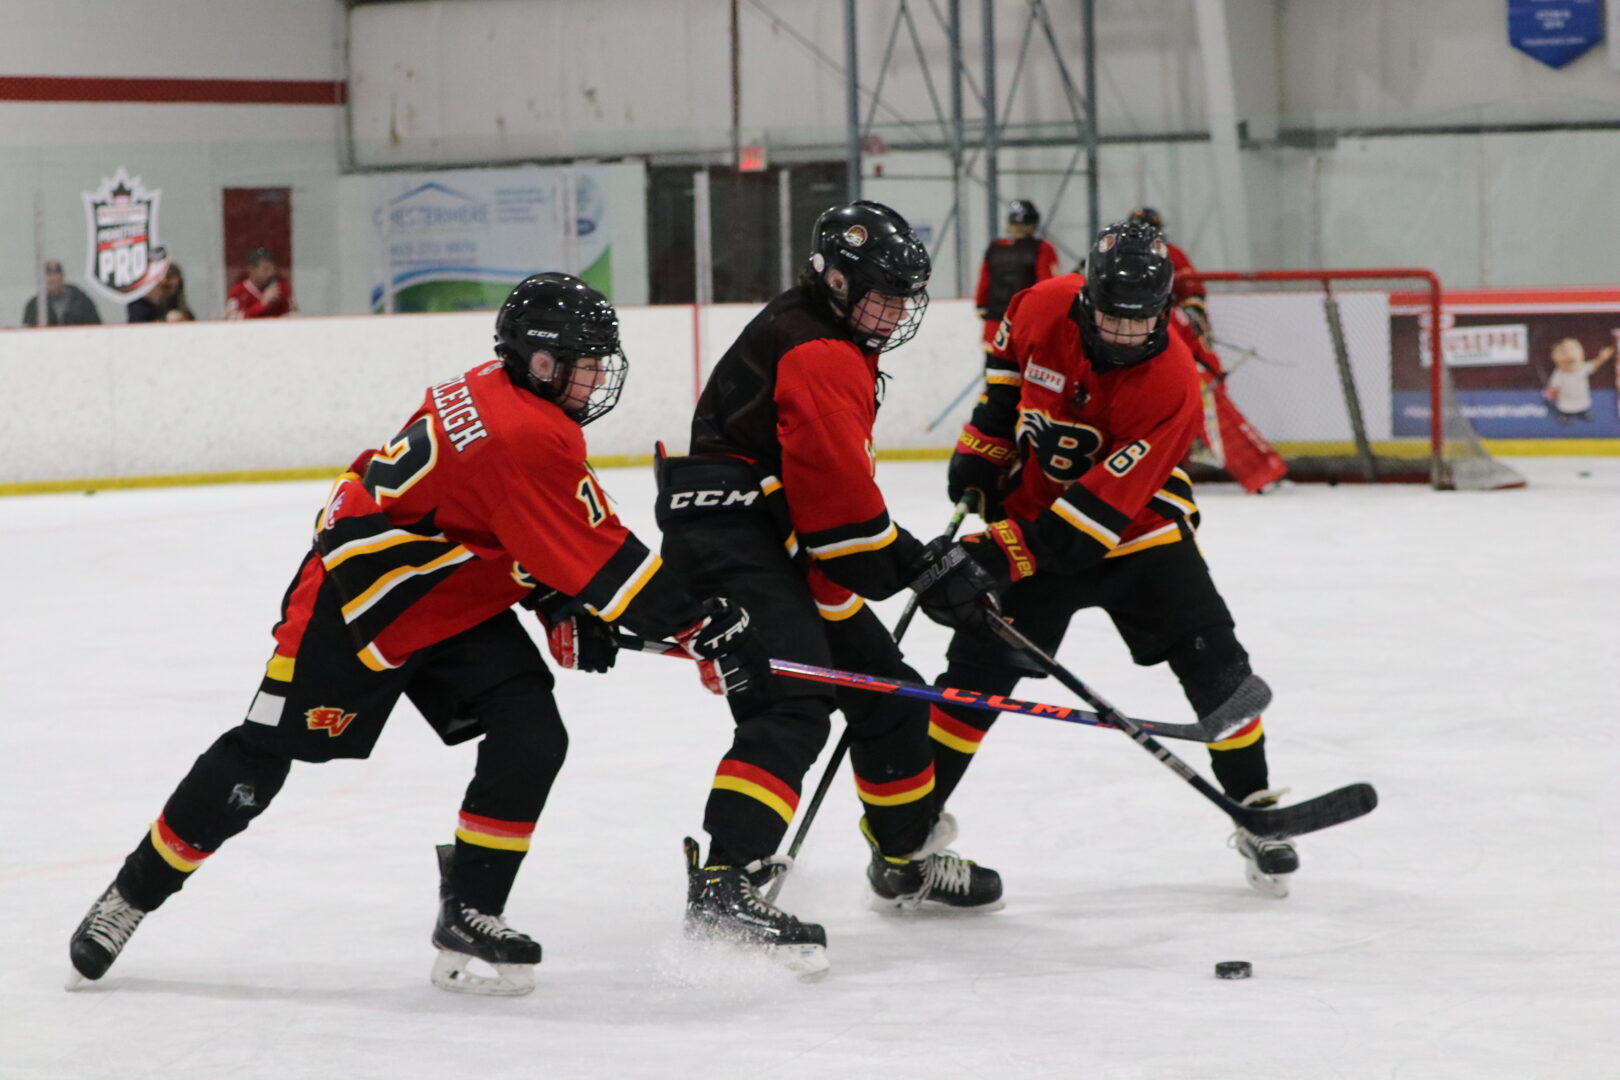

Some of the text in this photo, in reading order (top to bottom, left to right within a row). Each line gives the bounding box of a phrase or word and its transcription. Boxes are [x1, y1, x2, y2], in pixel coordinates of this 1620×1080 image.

[100, 244, 147, 287] PRO
[526, 329, 560, 339] CCM
[1103, 438, 1152, 478] 6
[575, 474, 615, 529] 1
[669, 489, 760, 510] CCM
[940, 687, 1073, 719] CCM
